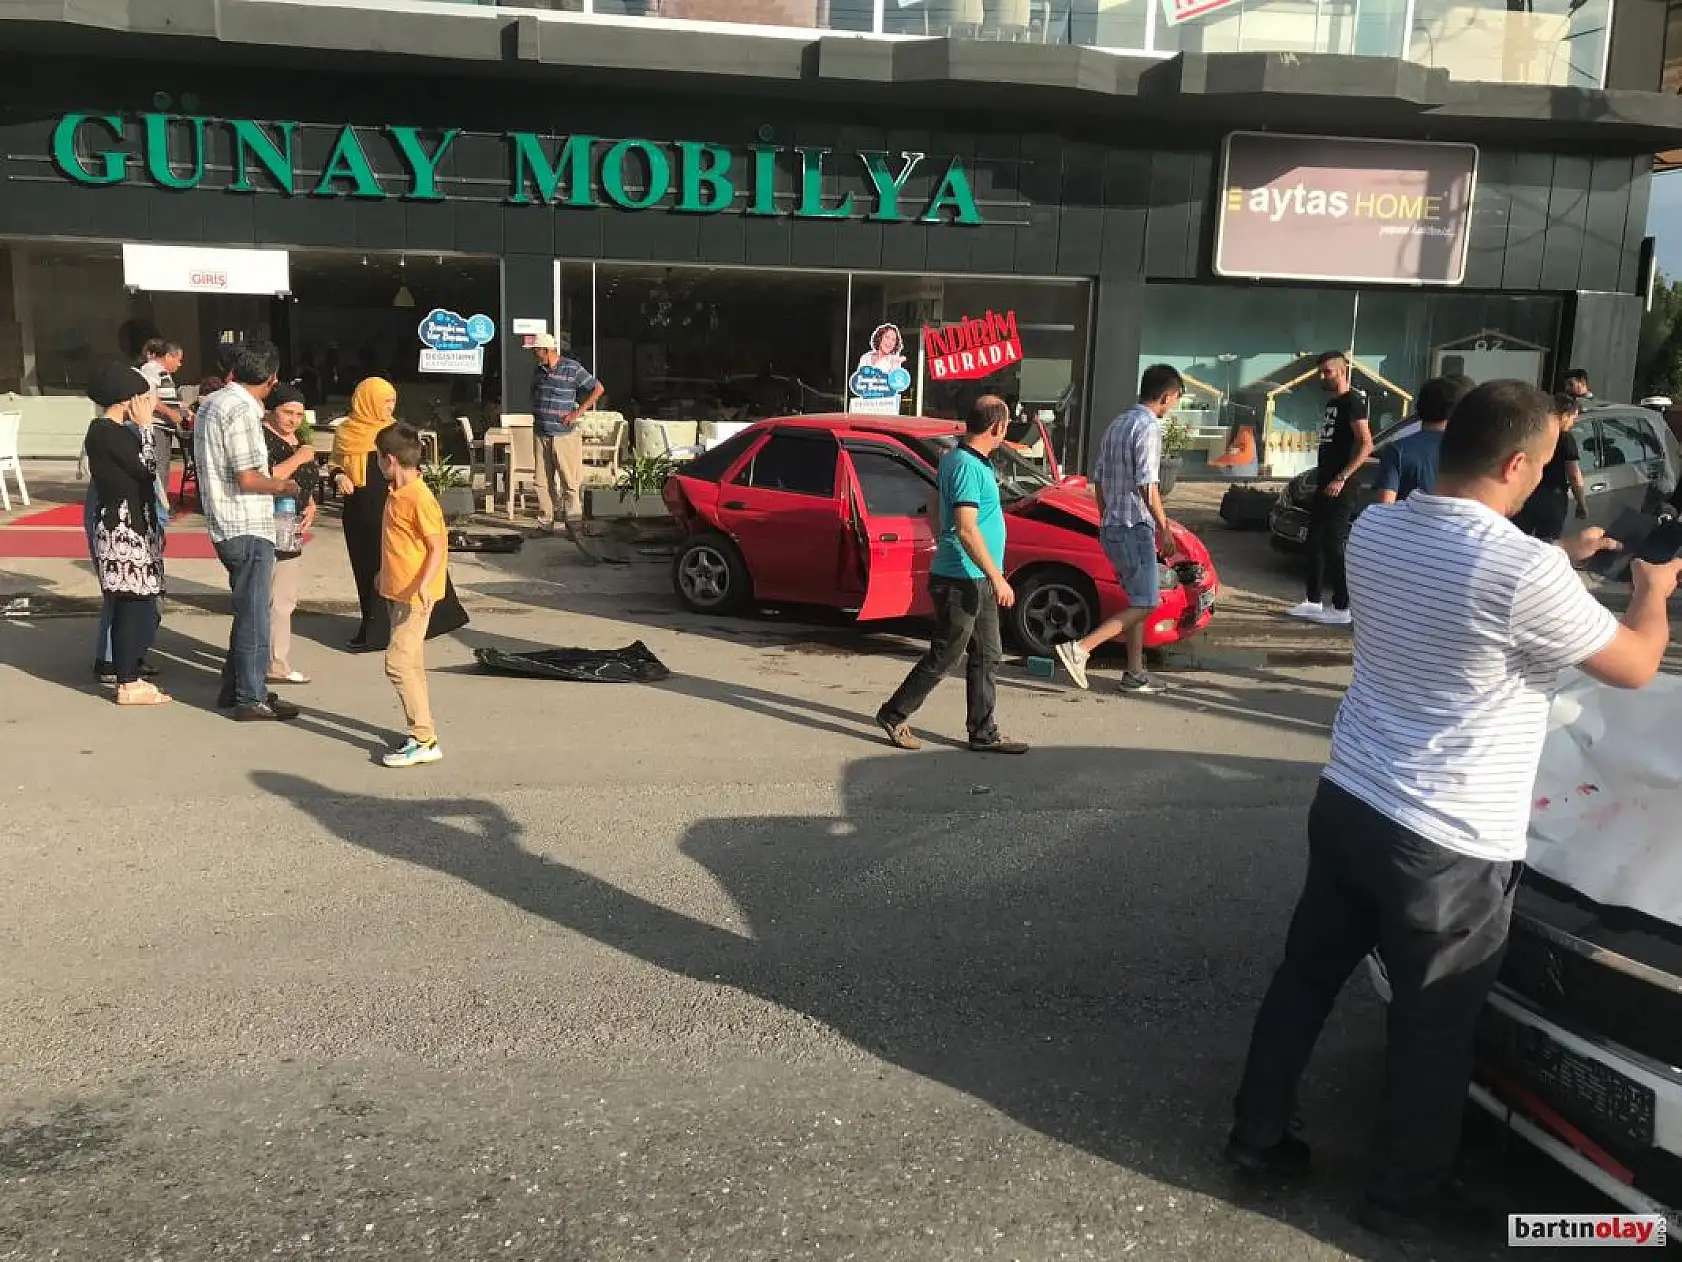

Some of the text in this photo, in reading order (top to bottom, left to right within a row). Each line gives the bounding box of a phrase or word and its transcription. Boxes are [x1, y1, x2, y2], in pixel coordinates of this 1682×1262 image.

[52, 91, 984, 224] GÜNAY MOBİLYA
[1354, 191, 1442, 221] HOME
[933, 341, 1017, 378] BURADA
